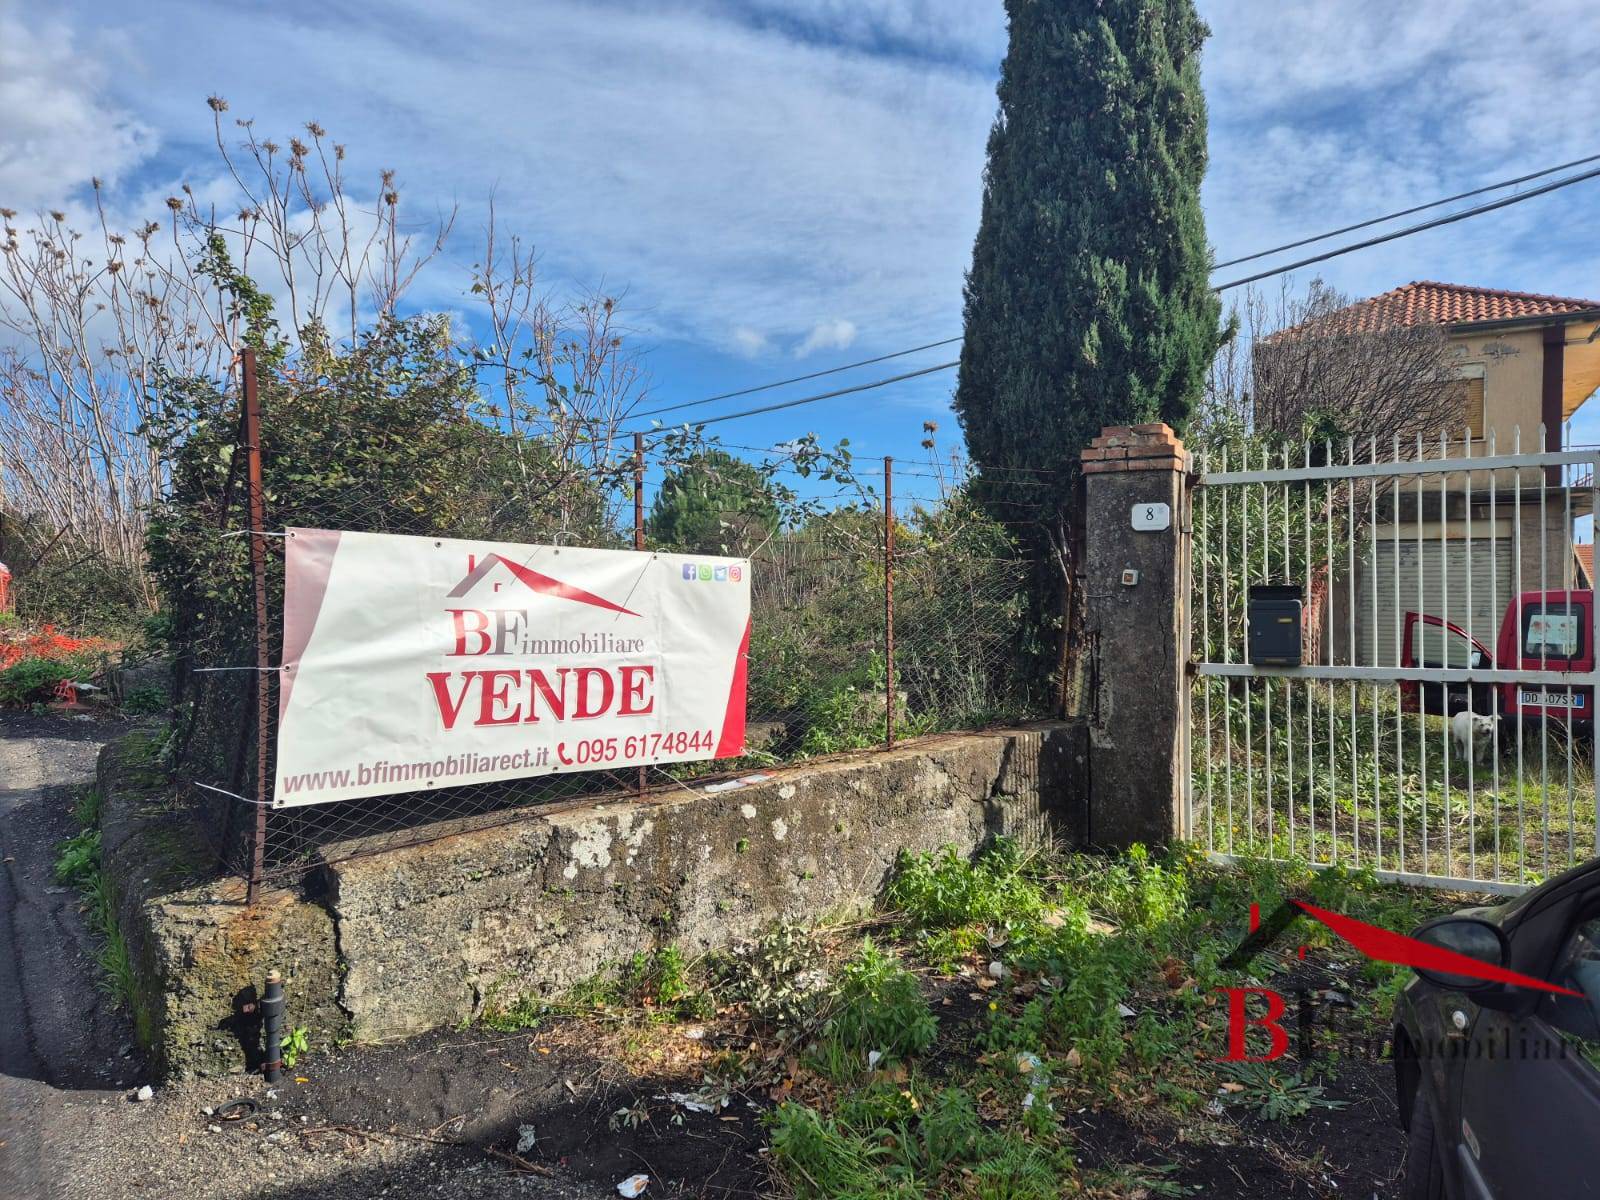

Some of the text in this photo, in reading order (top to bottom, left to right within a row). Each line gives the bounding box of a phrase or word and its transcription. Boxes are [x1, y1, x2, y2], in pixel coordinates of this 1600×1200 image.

[1146, 507, 1153, 520] 8
[425, 665, 654, 731] VENDE
[283, 730, 714, 794] www.bfimmobiliarect.it 095 6174844
